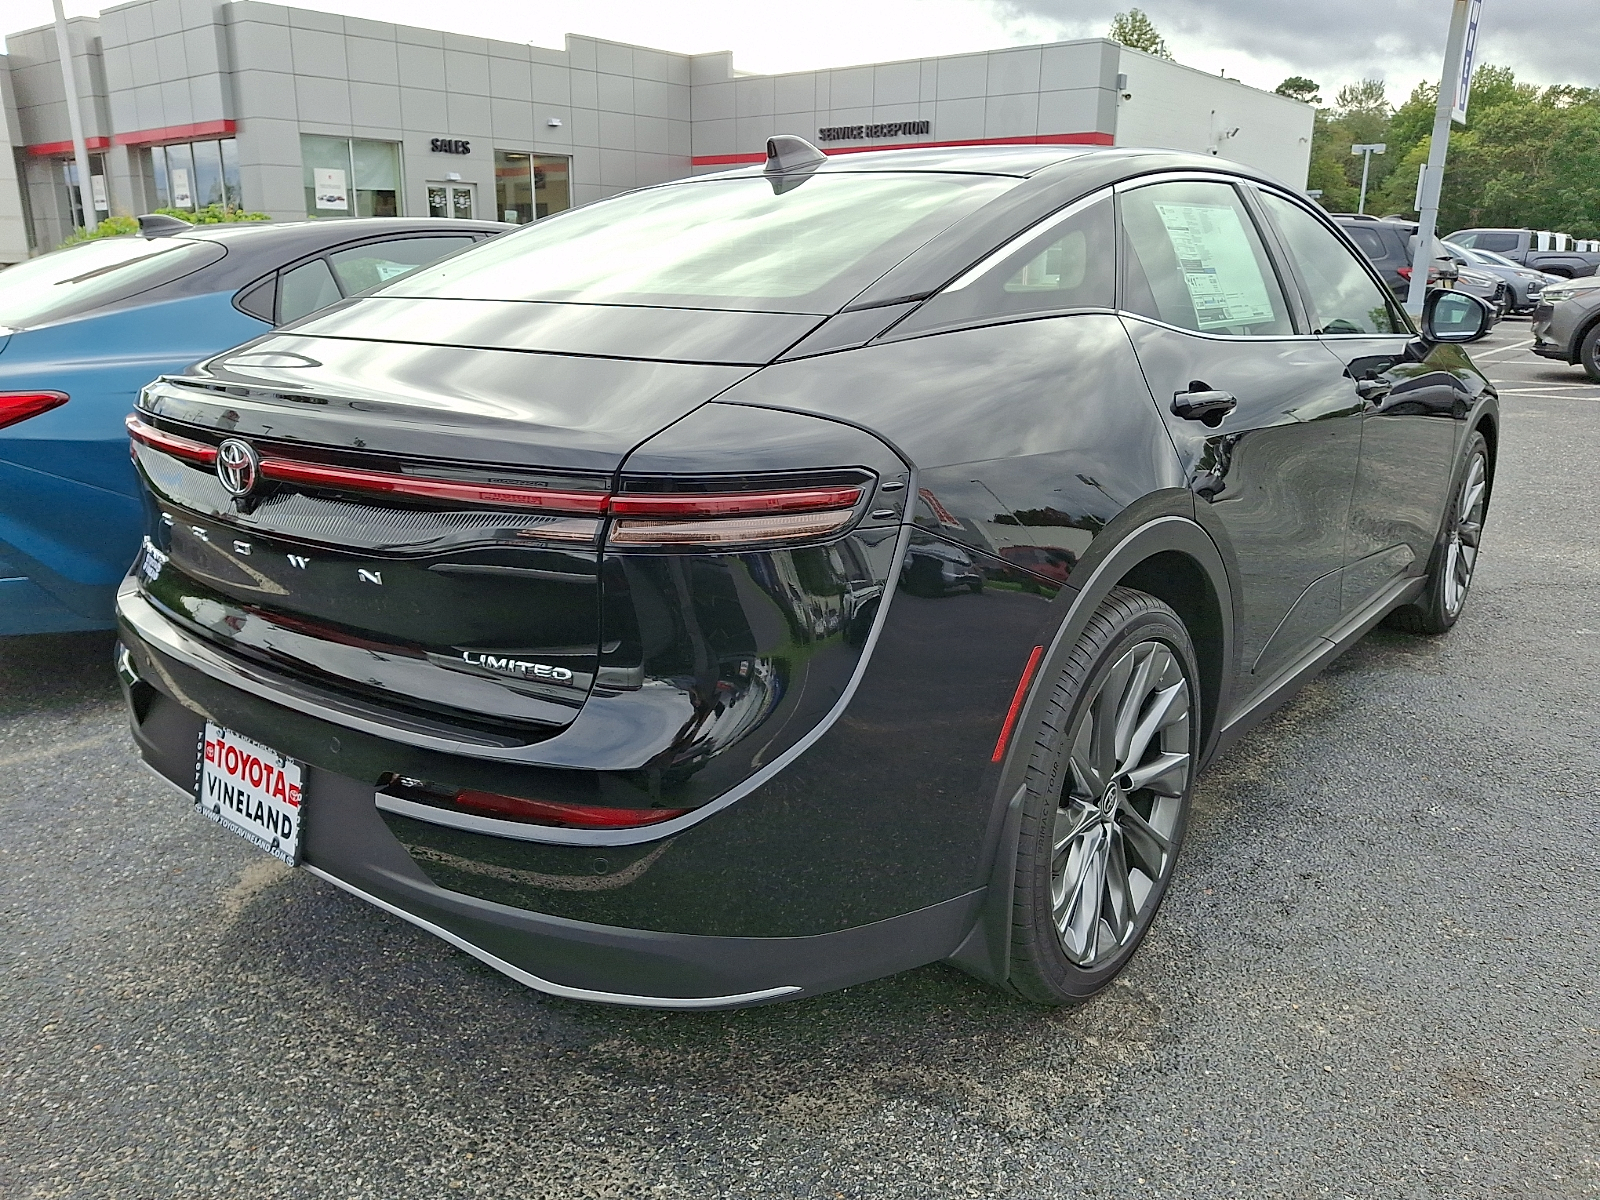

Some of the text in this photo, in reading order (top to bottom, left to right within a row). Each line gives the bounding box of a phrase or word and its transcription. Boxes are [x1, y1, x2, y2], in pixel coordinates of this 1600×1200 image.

[431, 138, 471, 154] SALES
[818, 120, 930, 141] SERVICE RECEPTION
[463, 651, 573, 680] LIMITED
[194, 731, 203, 791] TOYOTA
[215, 738, 287, 803] TOYOTA
[1046, 760, 1060, 794] TOUR
[206, 771, 293, 840] VINELAND
